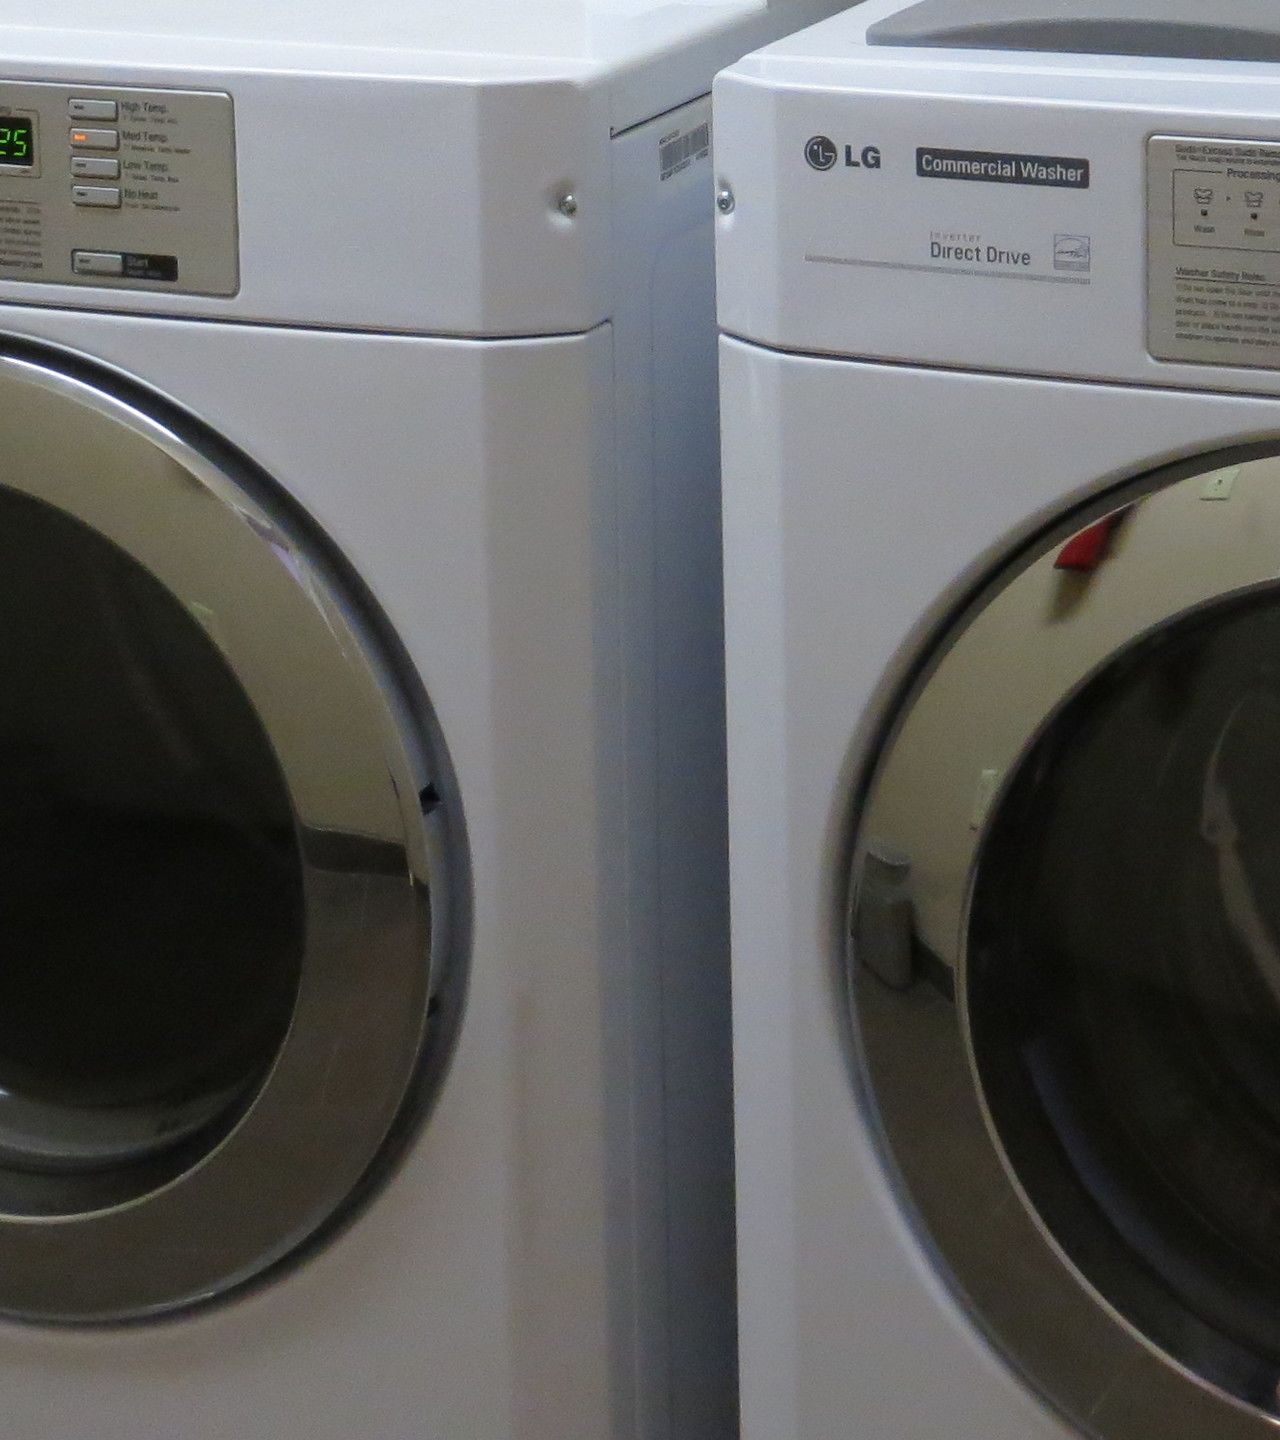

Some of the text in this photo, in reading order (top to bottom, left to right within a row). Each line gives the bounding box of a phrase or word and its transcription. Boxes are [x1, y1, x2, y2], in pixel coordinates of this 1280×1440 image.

[844, 144, 882, 170] LG
[921, 154, 1085, 182] Commercial Washer
[929, 241, 982, 263] Direct
[986, 245, 1032, 267] Drive
